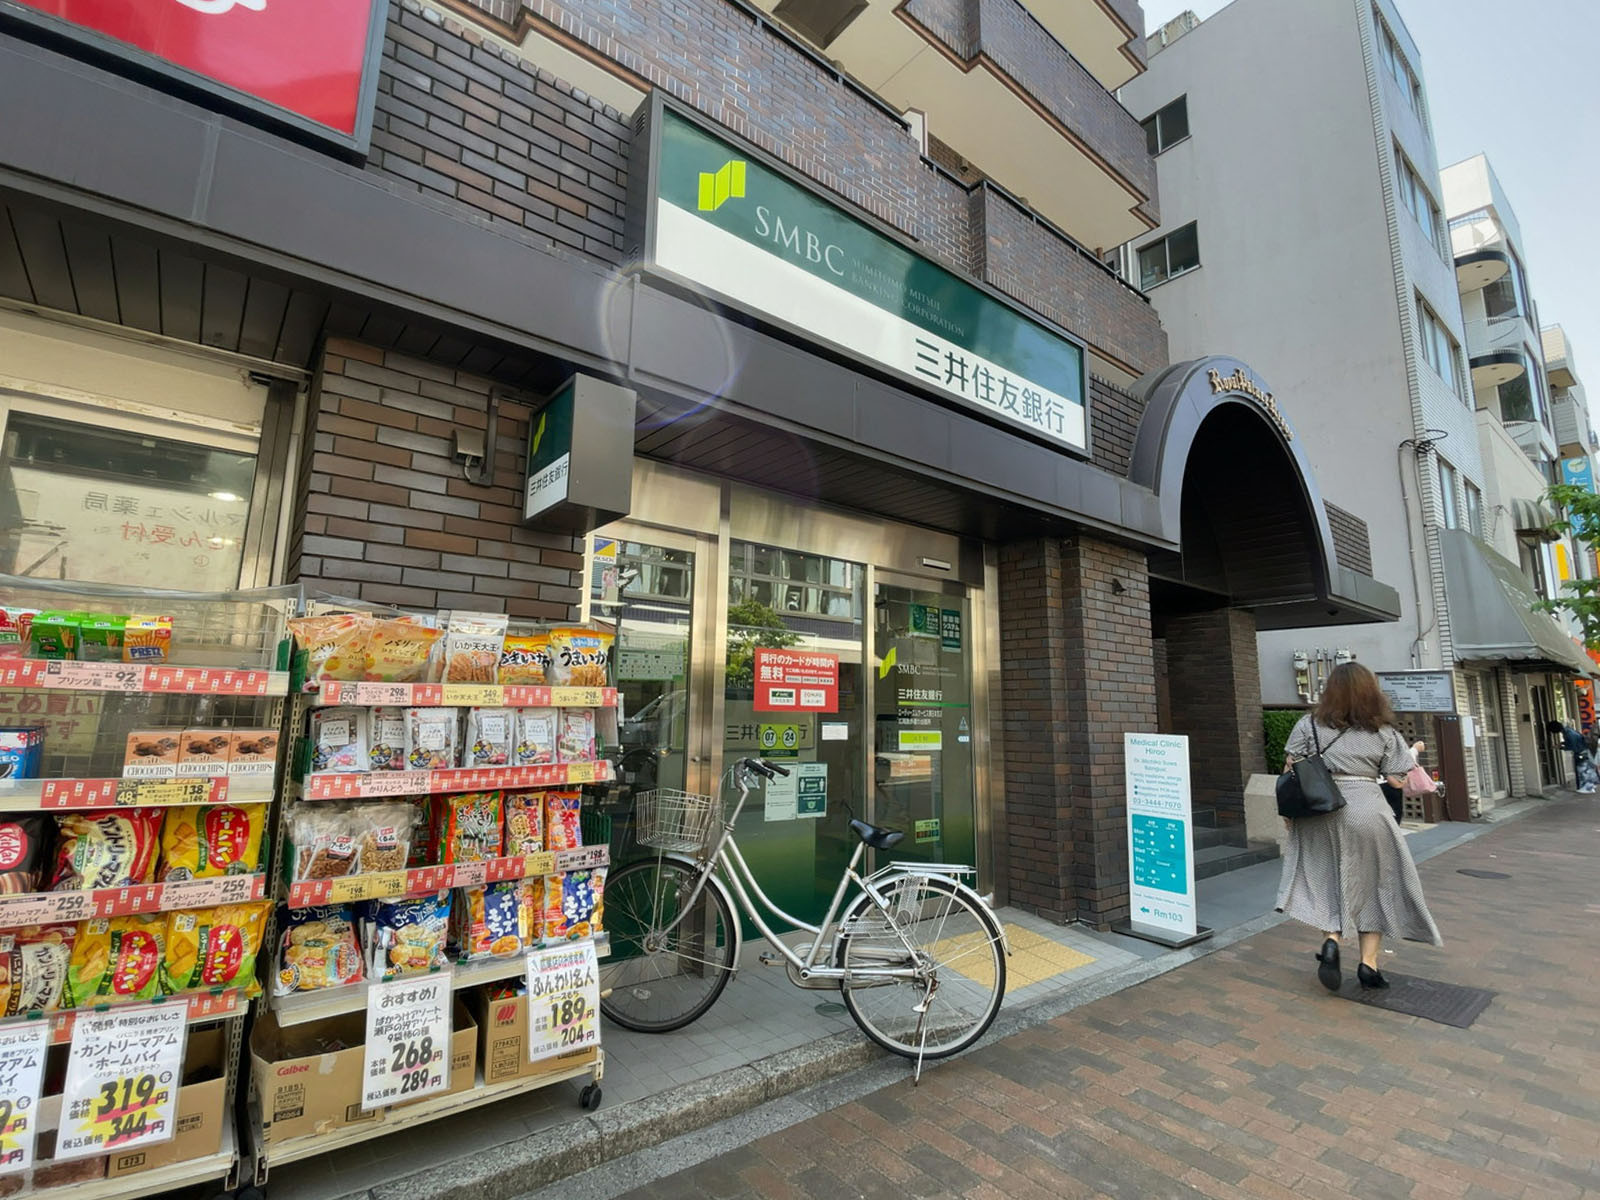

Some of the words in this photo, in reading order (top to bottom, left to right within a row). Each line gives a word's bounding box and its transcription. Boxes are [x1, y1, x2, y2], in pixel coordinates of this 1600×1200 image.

[755, 205, 845, 276] SMBC
[909, 288, 941, 311] MITSUI
[914, 337, 1066, 435] 三井住友銀行
[530, 461, 568, 496] 三井住友銀行
[454, 640, 497, 652] いか天大王
[131, 647, 163, 659] PRETZ
[560, 646, 608, 667] うまいか
[760, 652, 835, 669] 両行のカードが時間内
[760, 665, 784, 680] 無料
[897, 663, 921, 675] SMBC
[116, 671, 137, 683] 92
[390, 687, 405, 697] 298
[483, 689, 497, 698] 349
[898, 688, 943, 701] 三井住友銀行
[764, 731, 775, 741] 07
[784, 731, 795, 741] 24
[1130, 738, 1159, 747] Medical
[1160, 740, 1183, 748] Clinic
[127, 766, 174, 776] CHOCOCHIPS
[180, 764, 225, 774] CHOCOCHIPS
[231, 763, 272, 773] CHOCOCHIPS
[369, 784, 404, 794] かりんとう
[410, 777, 426, 788] 148
[183, 785, 204, 795] 138
[222, 879, 247, 893] 259
[56, 896, 85, 910] 259
[229, 892, 245, 901] 279
[576, 883, 593, 920] チーズ
[65, 911, 84, 920] 279
[499, 894, 518, 933] チーズ
[564, 895, 579, 924] もち
[1153, 908, 1183, 923] Rm103
[488, 908, 504, 937] もち
[533, 966, 595, 997] ふんわり名人
[381, 986, 438, 1009] おすすめ!
[552, 997, 586, 1028] 189
[586, 1008, 596, 1019] 円
[535, 1015, 548, 1025] 本体
[535, 1023, 548, 1032] 価格
[560, 1024, 585, 1048] 204
[586, 1030, 596, 1041] 円
[80, 1033, 178, 1058] カントリーマアム
[533, 1040, 559, 1054] 税込価格
[391, 1036, 433, 1073] 268
[432, 1049, 443, 1062] 円
[370, 1058, 386, 1068] 本体
[276, 1064, 311, 1077] Calbee
[369, 1066, 386, 1077] 価格
[400, 1068, 429, 1095] 289
[430, 1074, 442, 1087] 円
[98, 1074, 156, 1115] 319
[155, 1091, 169, 1104] 円
[366, 1087, 398, 1101] 税込価格
[70, 1098, 91, 1110] 本体
[69, 1108, 90, 1120] 価格
[13, 1117, 27, 1132] 円
[107, 1111, 148, 1142] 344
[151, 1120, 165, 1134] 円
[62, 1134, 104, 1150] 税込価格
[9, 1149, 24, 1164] 円
